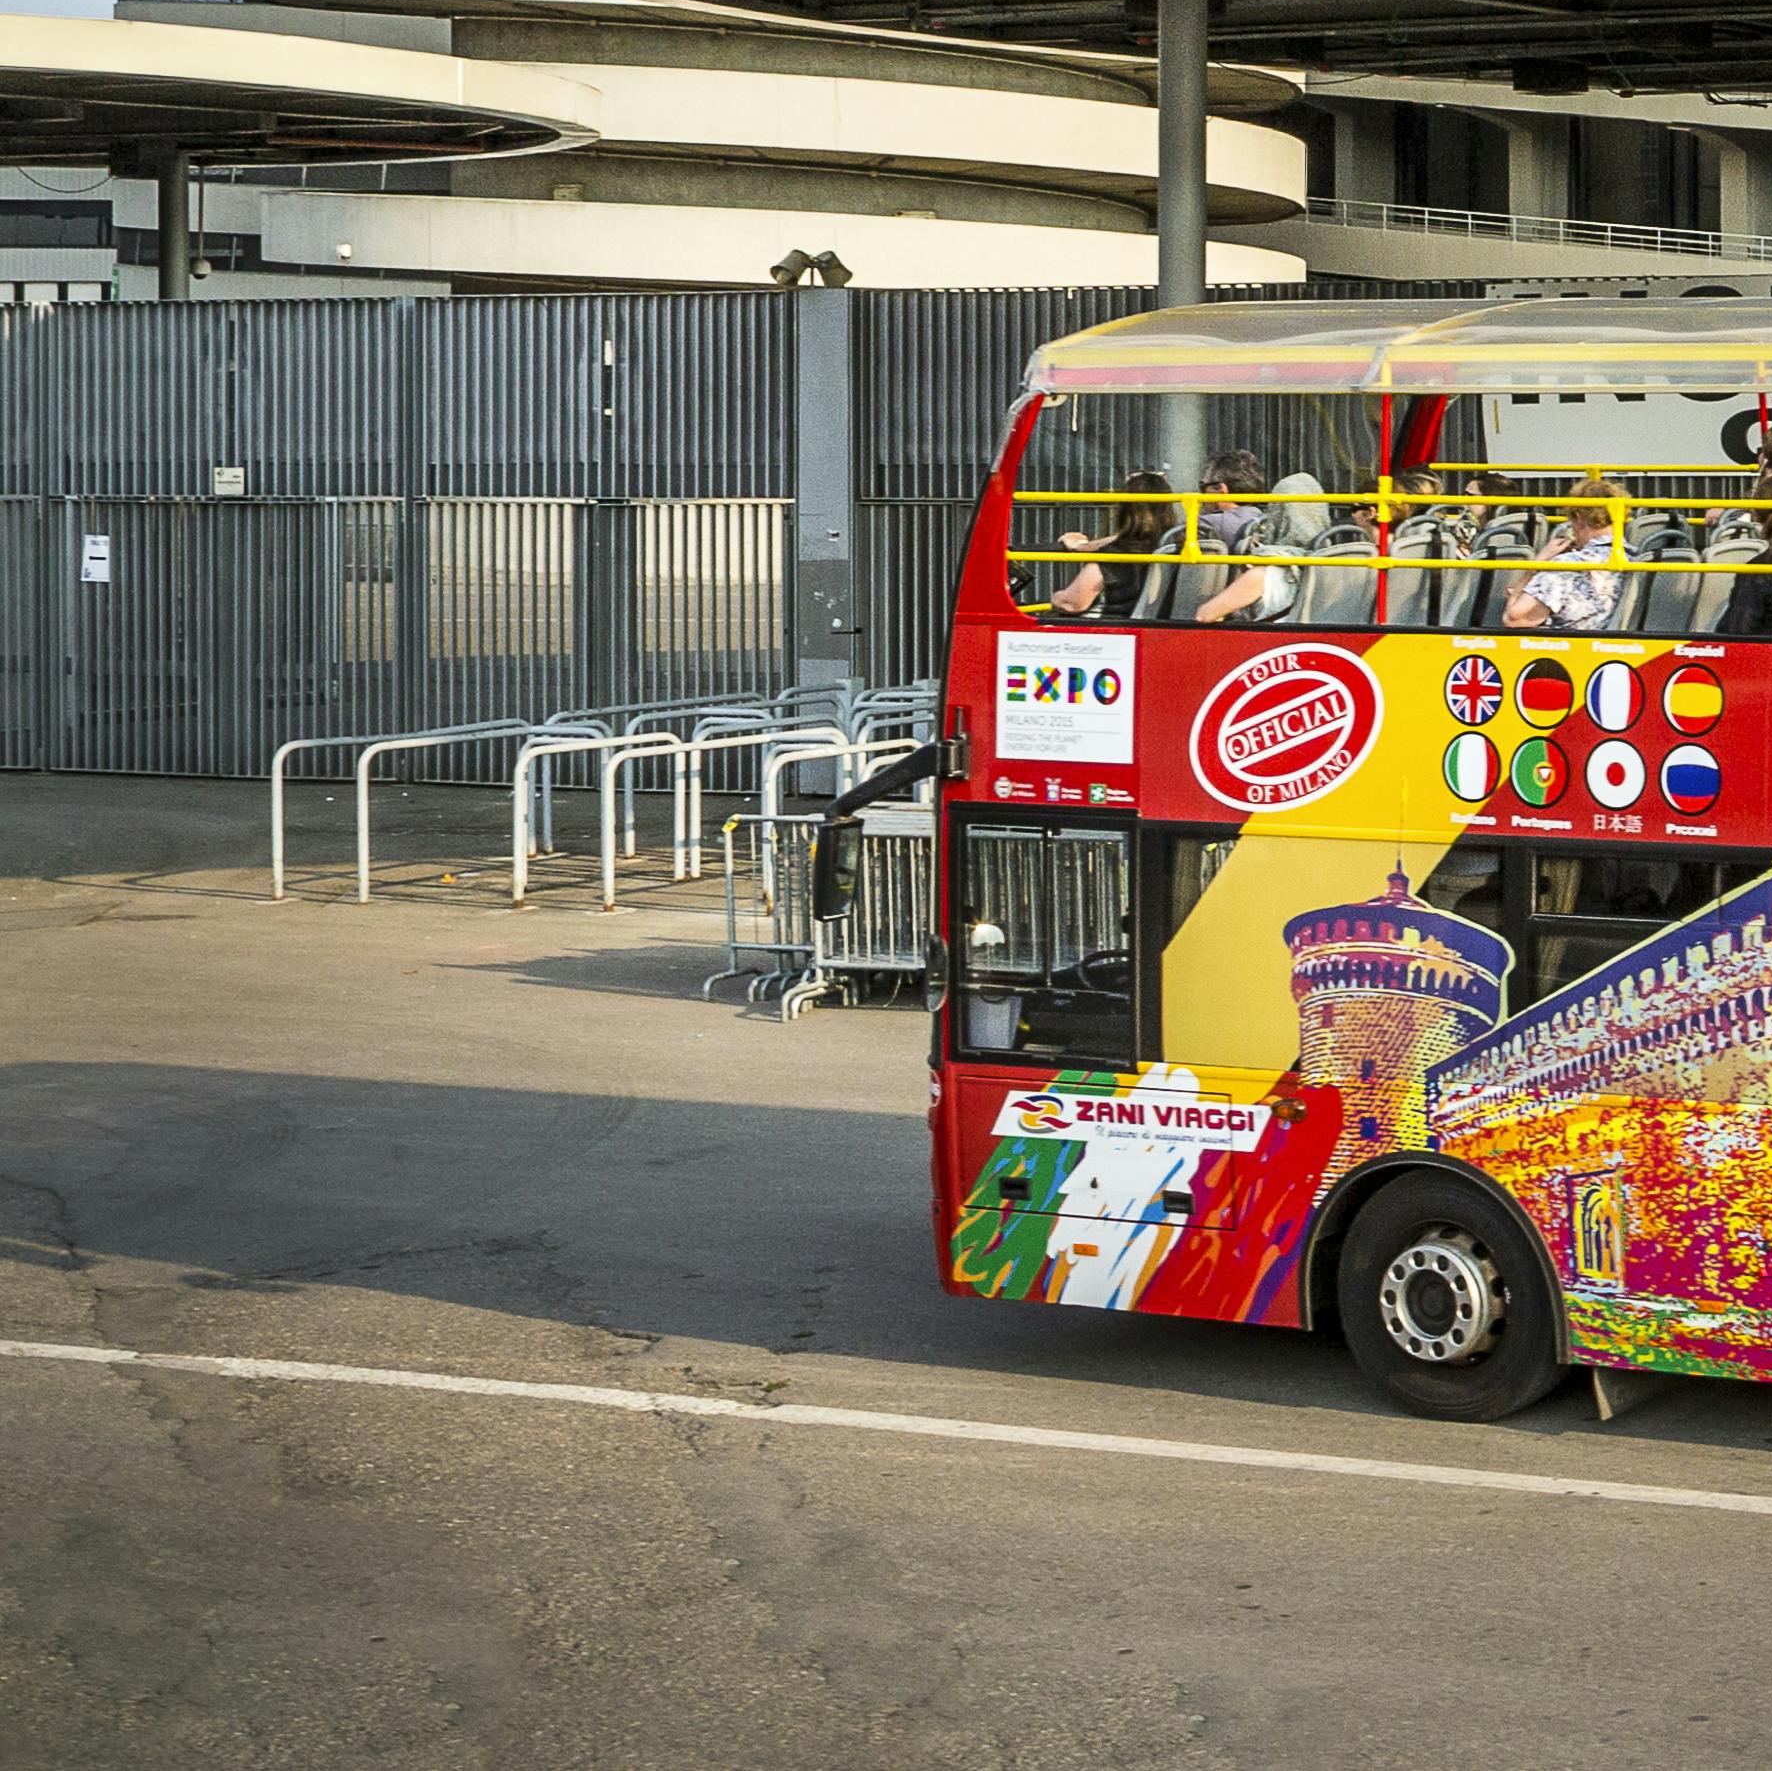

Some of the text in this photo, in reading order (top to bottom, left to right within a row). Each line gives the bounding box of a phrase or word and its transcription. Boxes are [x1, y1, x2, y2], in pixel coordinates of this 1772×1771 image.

[1674, 644, 1726, 659] Español
[1007, 665, 1121, 705] EXPO
[1238, 653, 1302, 690] TOUR
[1006, 715, 1074, 727] MILANO 2015
[1227, 693, 1348, 761] OFFICIAL
[1247, 750, 1352, 803] OF MILANO
[1593, 814, 1643, 833] 日本語
[1075, 1100, 1254, 1131] ZANI VIAGGI
